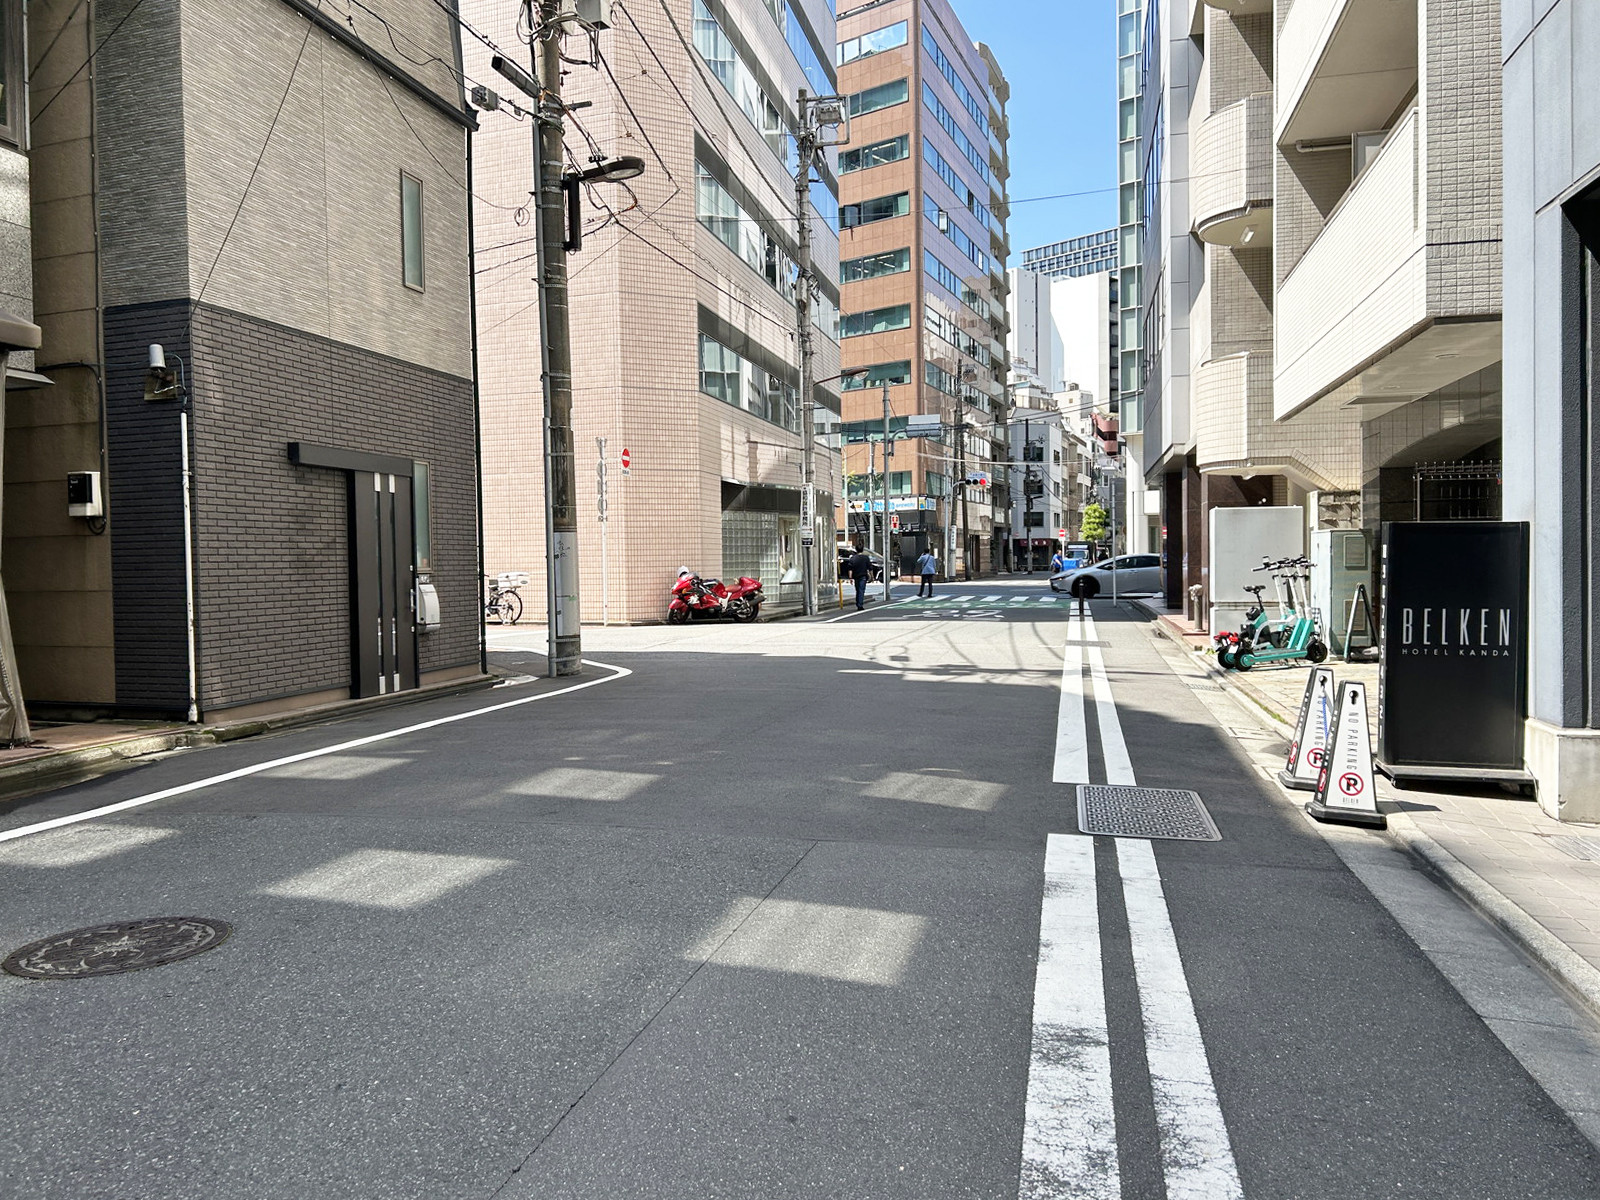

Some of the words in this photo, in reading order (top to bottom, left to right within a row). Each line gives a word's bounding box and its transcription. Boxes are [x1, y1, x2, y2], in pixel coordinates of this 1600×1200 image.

[1402, 608, 1511, 646] BELKEN
[1402, 648, 1449, 656] HOTEL
[1459, 649, 1509, 657] KANDA
[1347, 711, 1359, 724] NO
[1346, 729, 1359, 770] PARKING
